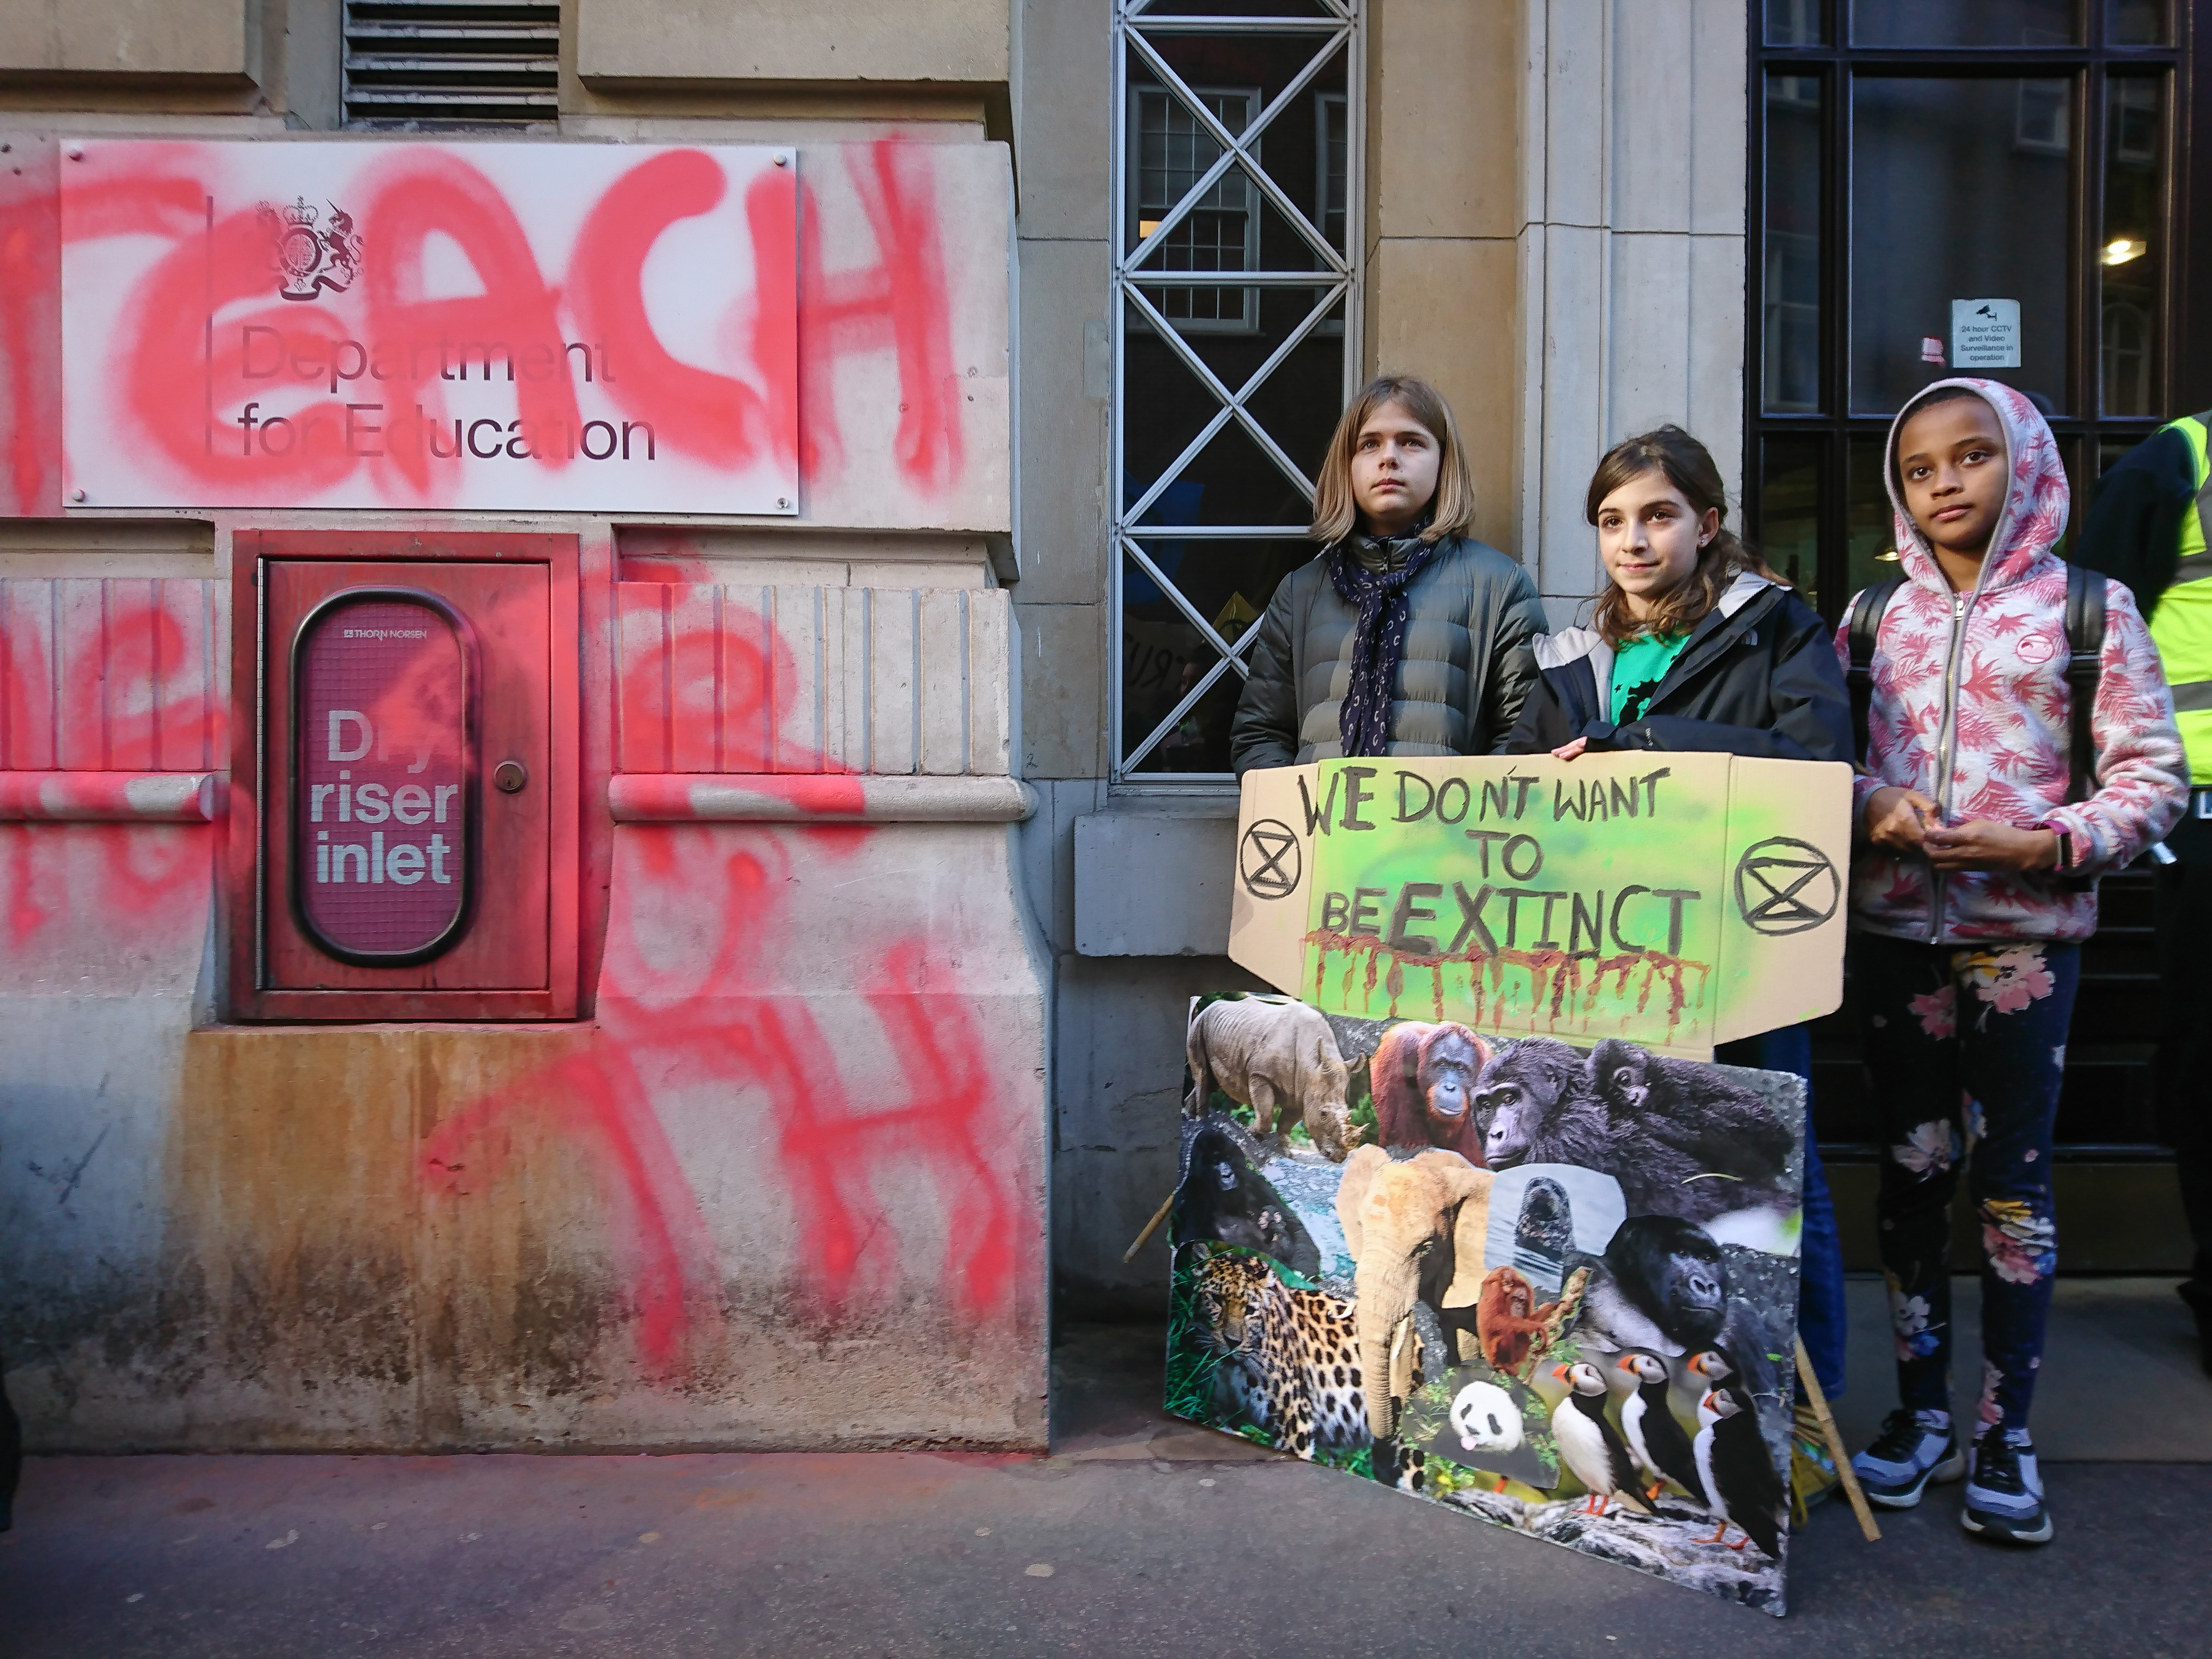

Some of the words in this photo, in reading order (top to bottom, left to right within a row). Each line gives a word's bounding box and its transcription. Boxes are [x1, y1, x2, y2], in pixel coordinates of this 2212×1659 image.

[242, 326, 616, 394] Department
[237, 403, 319, 457] for
[345, 403, 656, 460] Education
[354, 630, 388, 641] THORN
[310, 770, 459, 825] riser
[1298, 766, 1377, 836] WE
[1391, 766, 1540, 824] DON'T
[1553, 766, 1671, 823] WANT
[316, 830, 452, 885] inlet
[1465, 829, 1544, 881] TO
[1322, 887, 1388, 937] BE
[1385, 882, 1702, 957] EXTINCT
